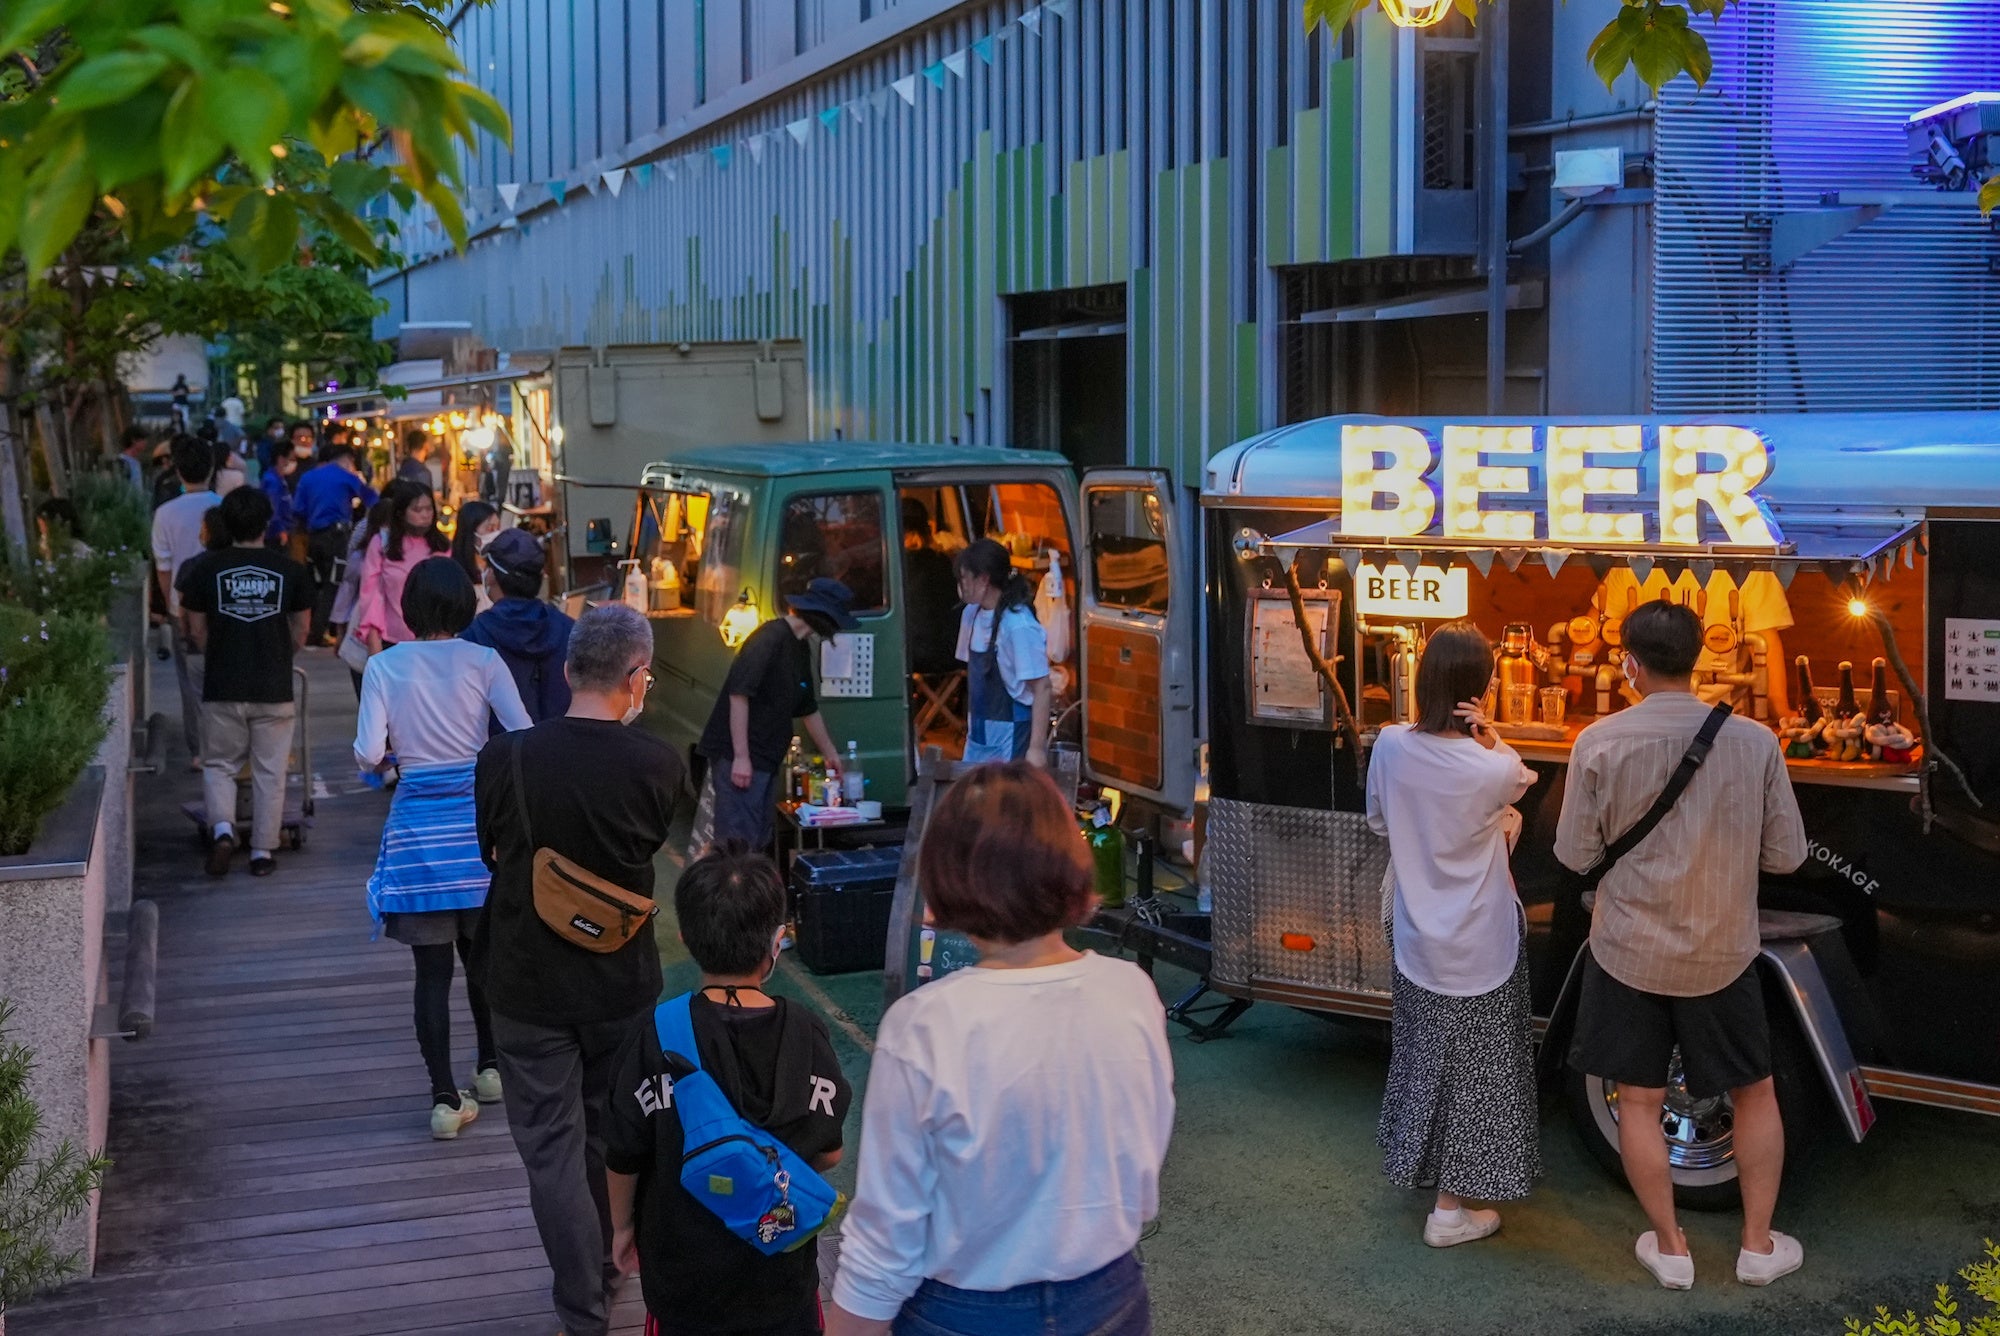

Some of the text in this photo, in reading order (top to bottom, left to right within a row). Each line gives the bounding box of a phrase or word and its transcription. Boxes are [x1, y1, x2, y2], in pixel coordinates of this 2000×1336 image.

[1341, 425, 1784, 546] BEER
[1368, 577, 1440, 603] BEER
[1806, 839, 1880, 895] KOKAGE
